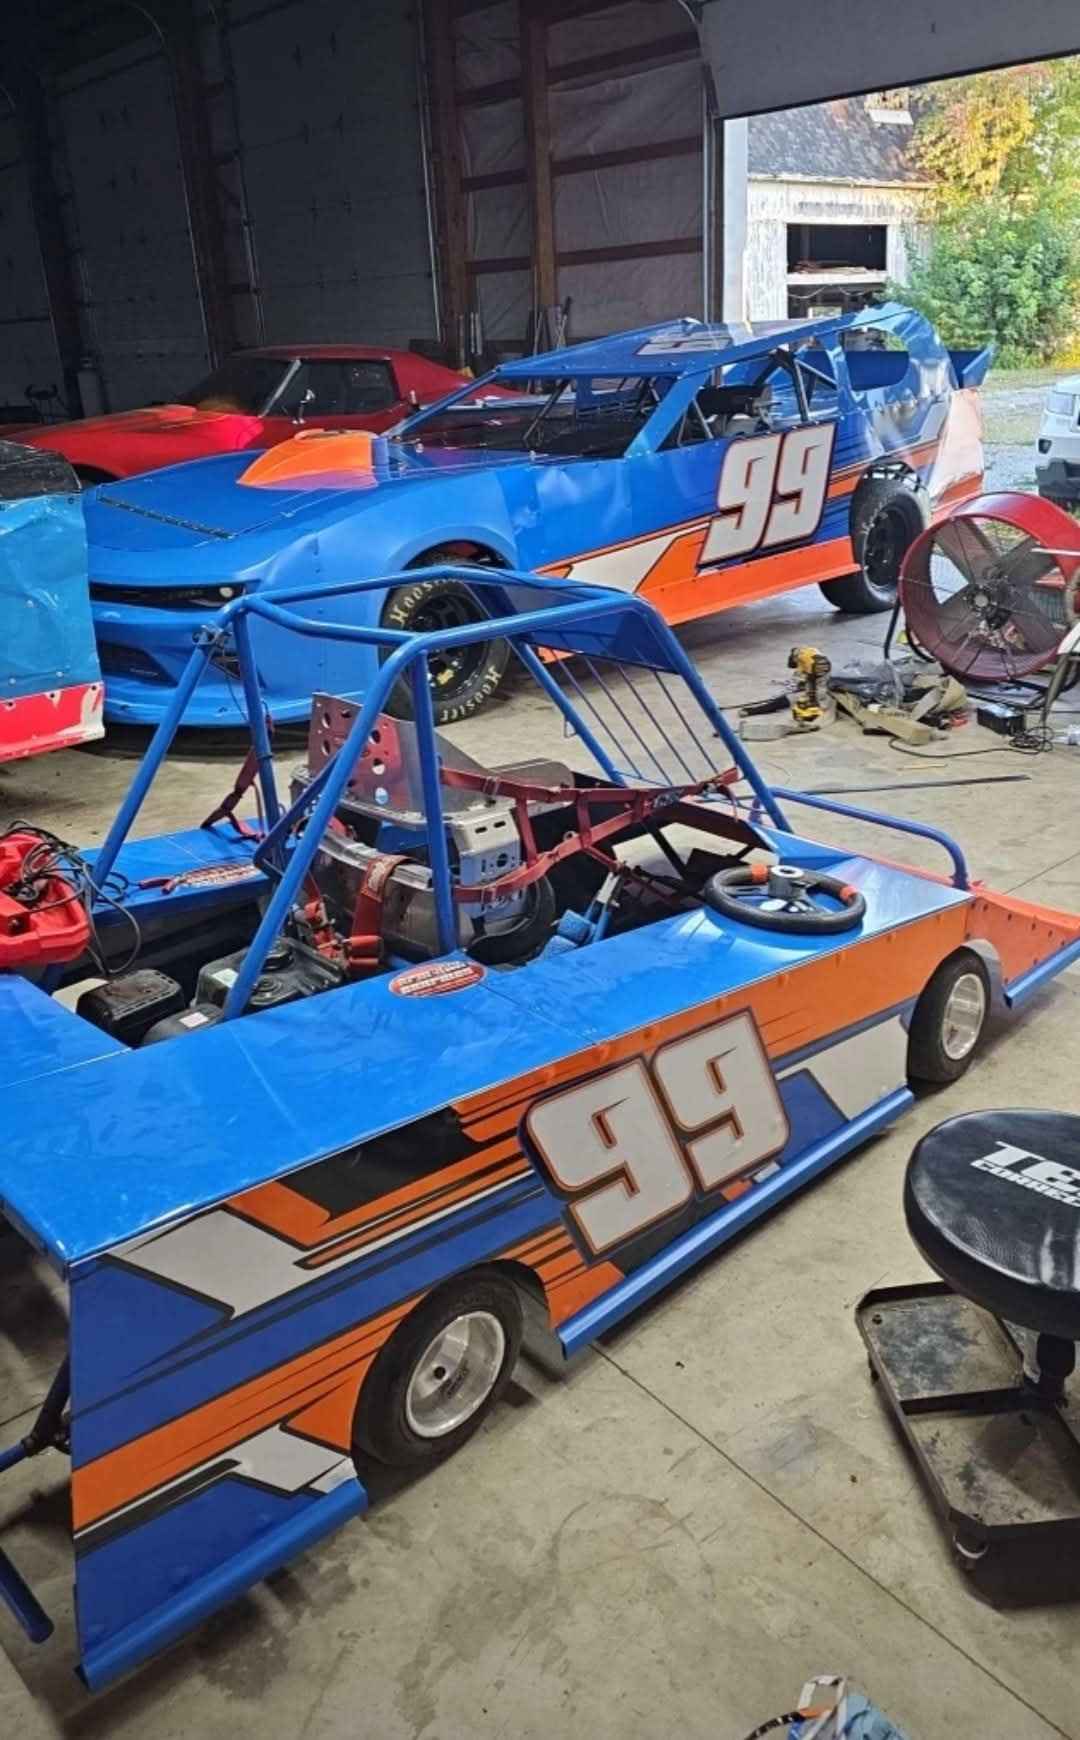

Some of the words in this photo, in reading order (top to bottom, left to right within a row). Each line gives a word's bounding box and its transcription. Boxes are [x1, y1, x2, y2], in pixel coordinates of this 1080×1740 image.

[698, 422, 837, 566] 99
[389, 579, 459, 627] Hoos
[525, 1009, 789, 1256] 99
[982, 1141, 1080, 1194] TE
